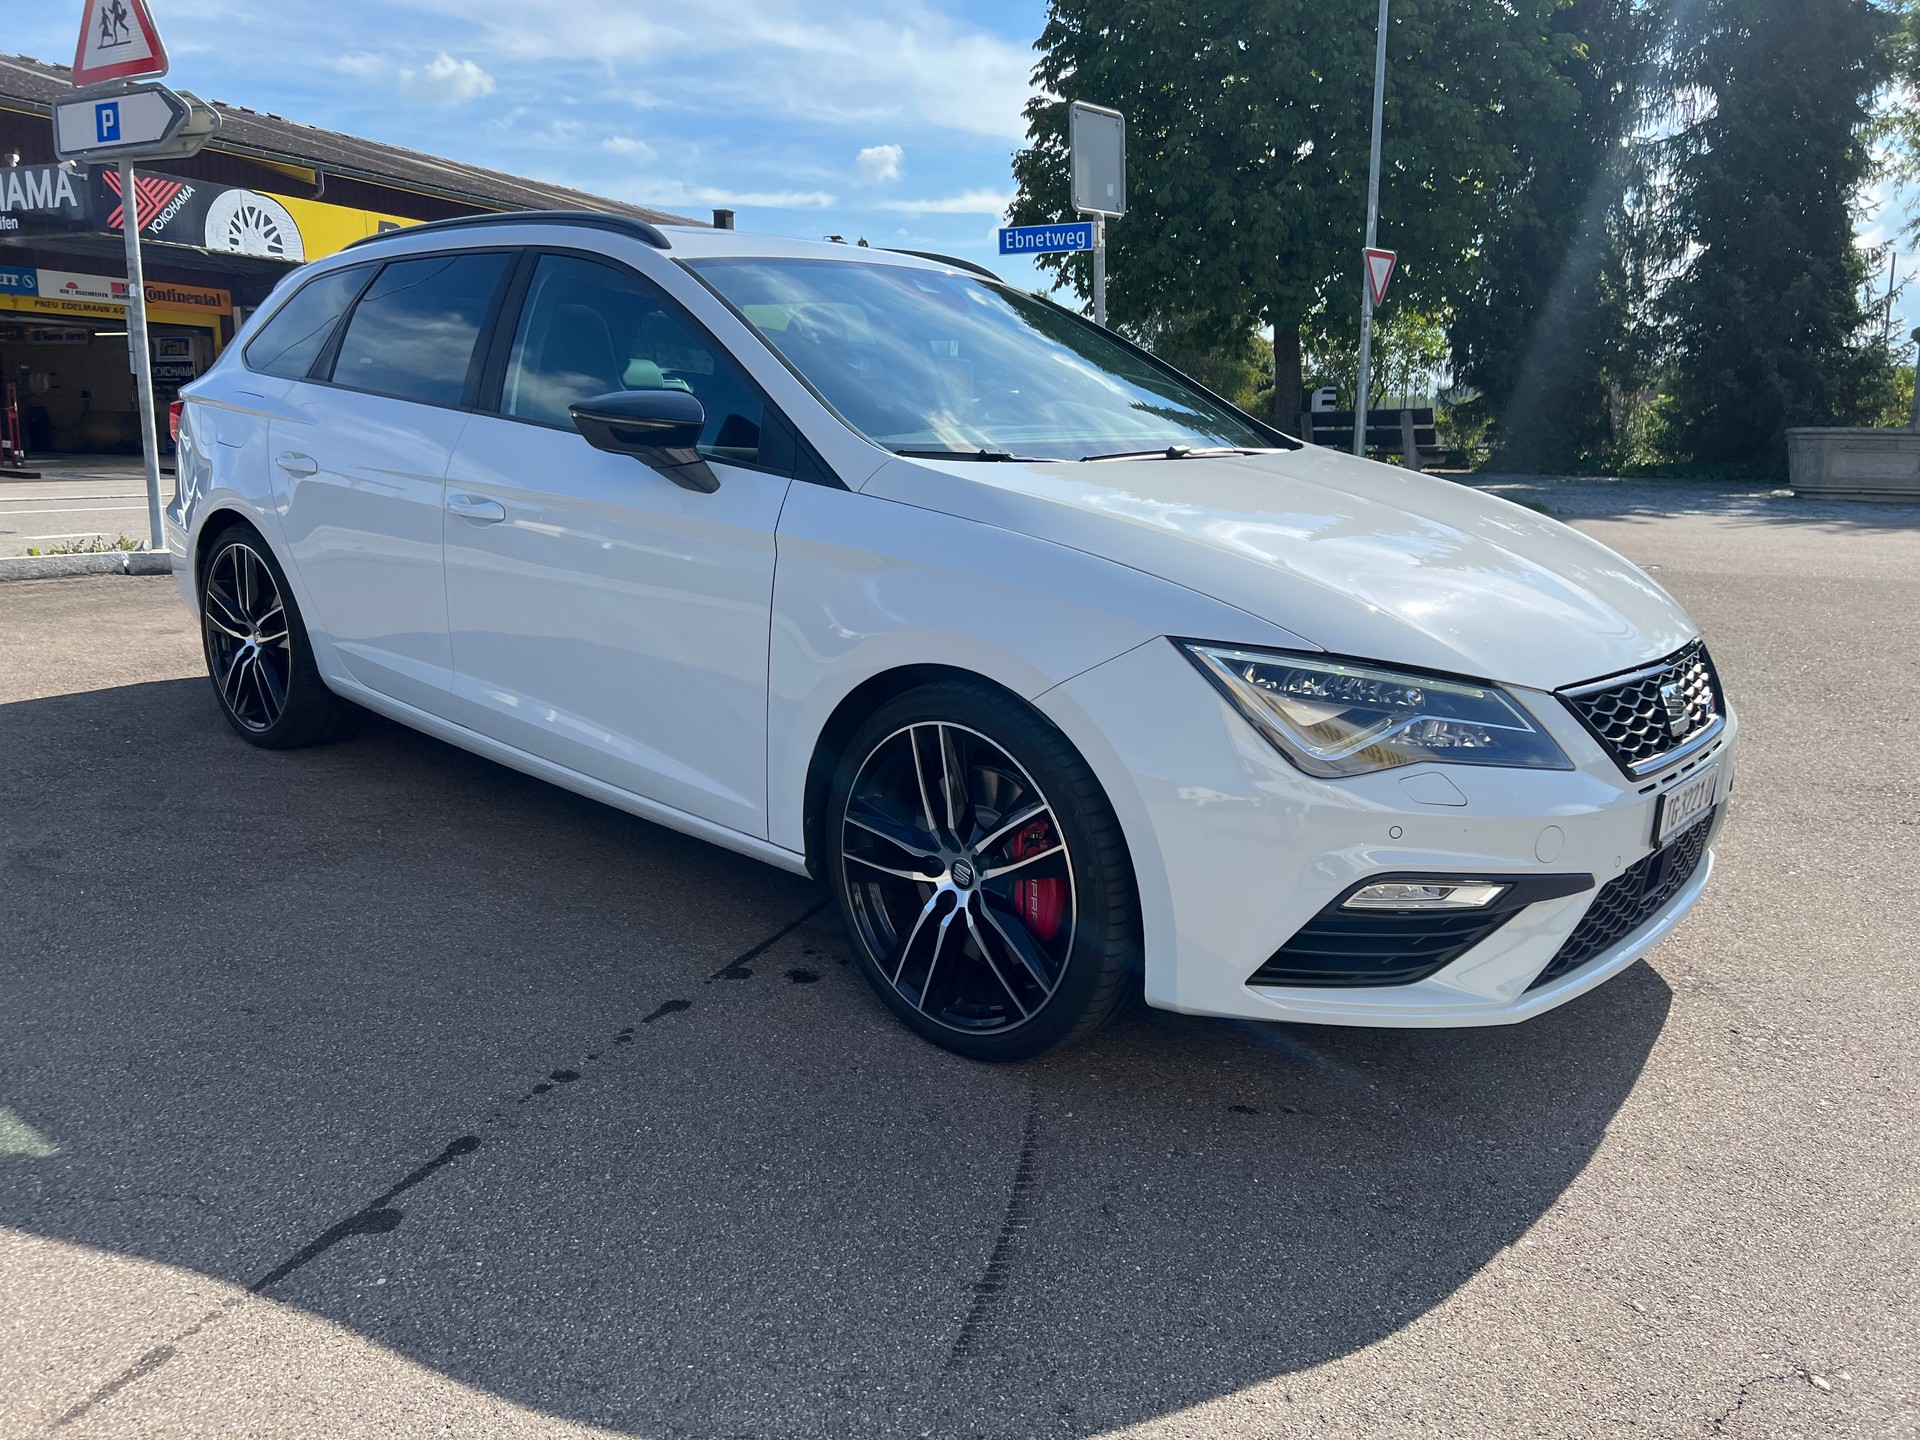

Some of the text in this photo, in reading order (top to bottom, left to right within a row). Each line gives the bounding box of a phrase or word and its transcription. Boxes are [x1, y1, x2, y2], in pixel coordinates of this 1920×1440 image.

[102, 109, 114, 137] P
[0, 169, 78, 211] AMA
[148, 185, 195, 234] YOKOHAMA
[1005, 229, 1086, 249] Ebnetweg
[34, 300, 59, 309] PNEU
[62, 302, 110, 313] EDELMANN
[144, 286, 221, 306] Continental
